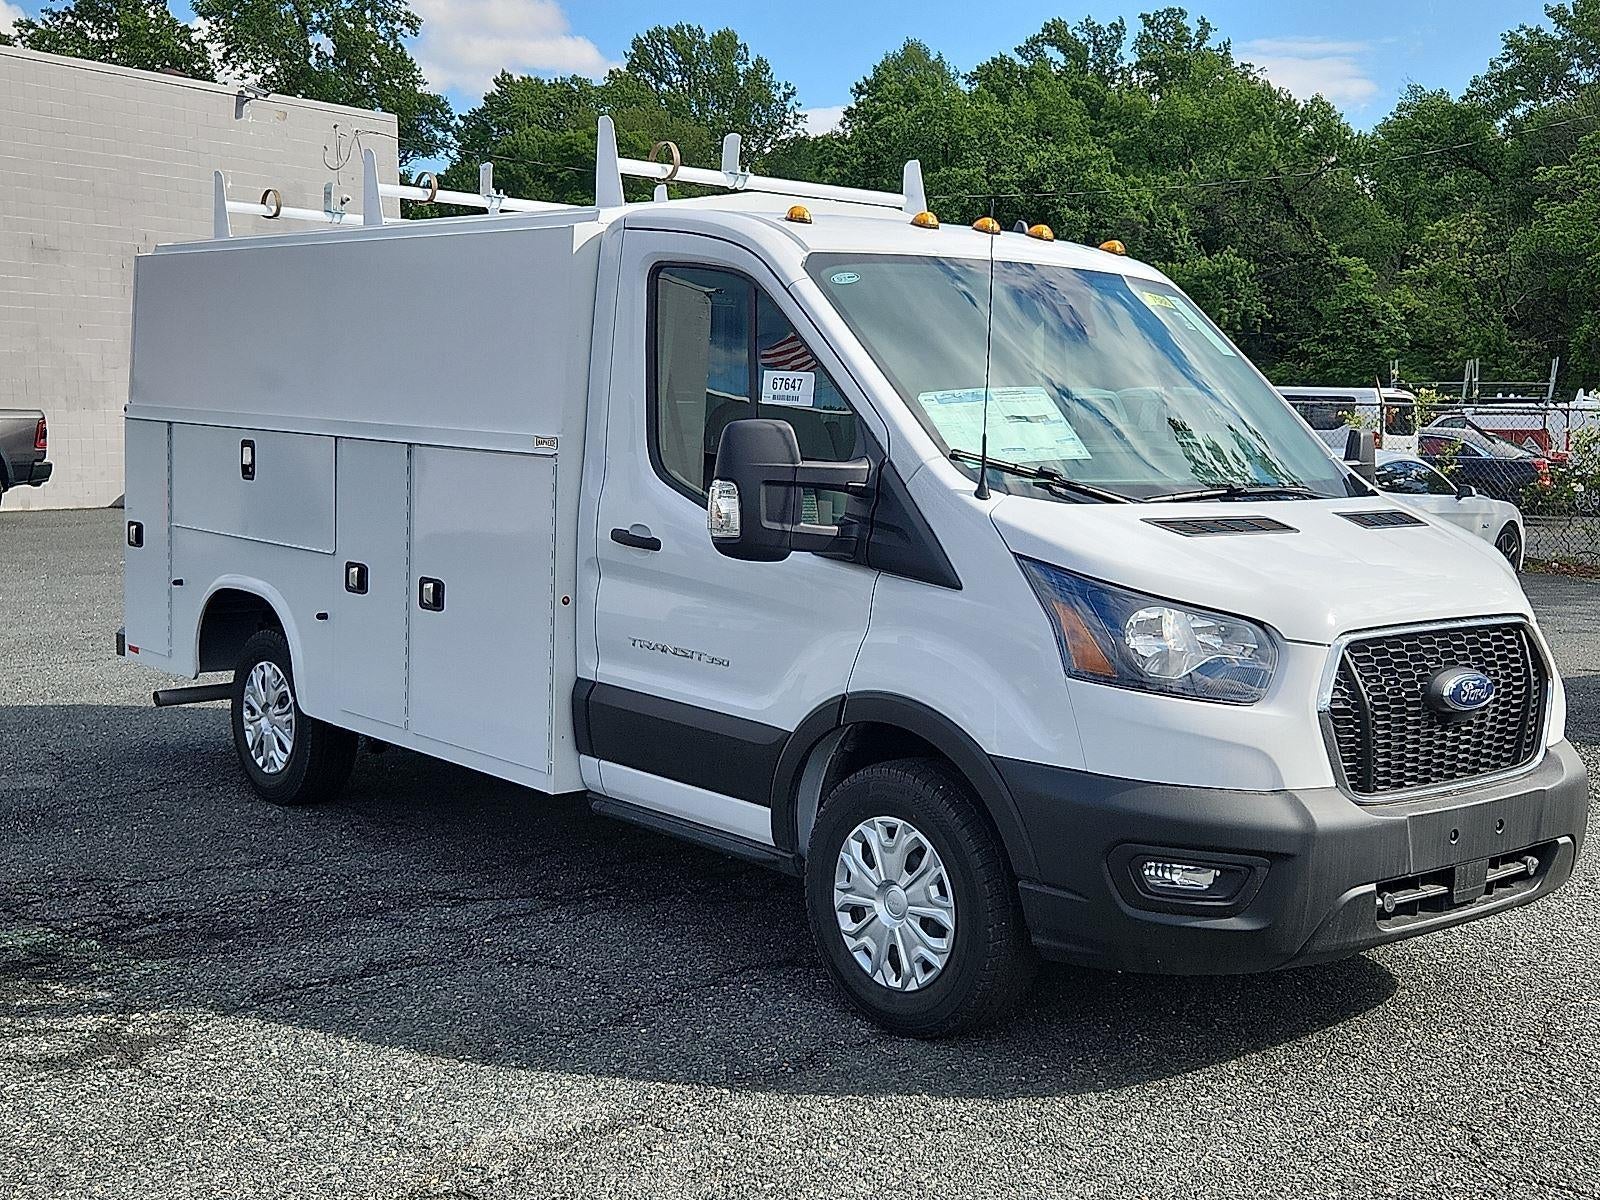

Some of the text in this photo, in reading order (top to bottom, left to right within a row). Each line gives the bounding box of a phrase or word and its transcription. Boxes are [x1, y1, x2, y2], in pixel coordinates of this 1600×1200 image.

[772, 377, 803, 391] 67647
[628, 636, 730, 668] TRANSIT 350
[1460, 679, 1488, 703] Ford
